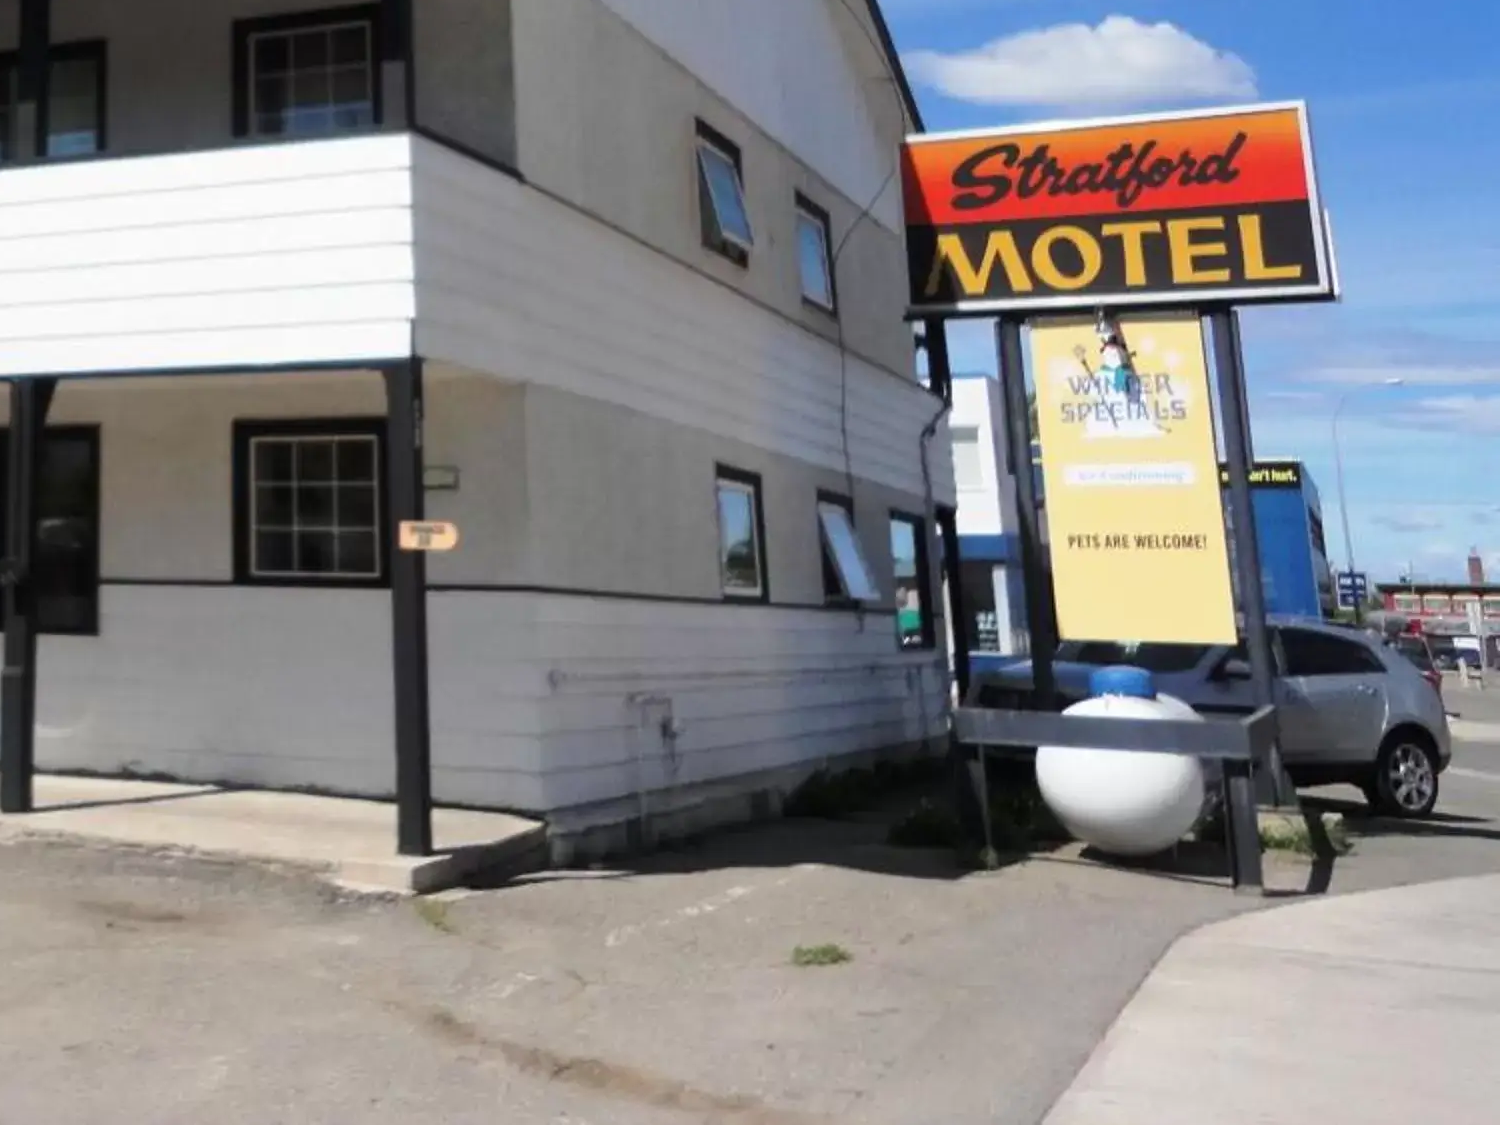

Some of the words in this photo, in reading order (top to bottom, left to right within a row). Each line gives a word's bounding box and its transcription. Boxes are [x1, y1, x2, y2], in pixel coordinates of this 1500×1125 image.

[951, 131, 1247, 210] Stratford
[924, 214, 1302, 296] MOTEL
[1067, 372, 1175, 396] WINER
[1060, 399, 1188, 423] SPECIALS
[1067, 534, 1101, 550] PETS
[1104, 534, 1130, 550] ARE
[1135, 533, 1208, 550] WELCOME!
